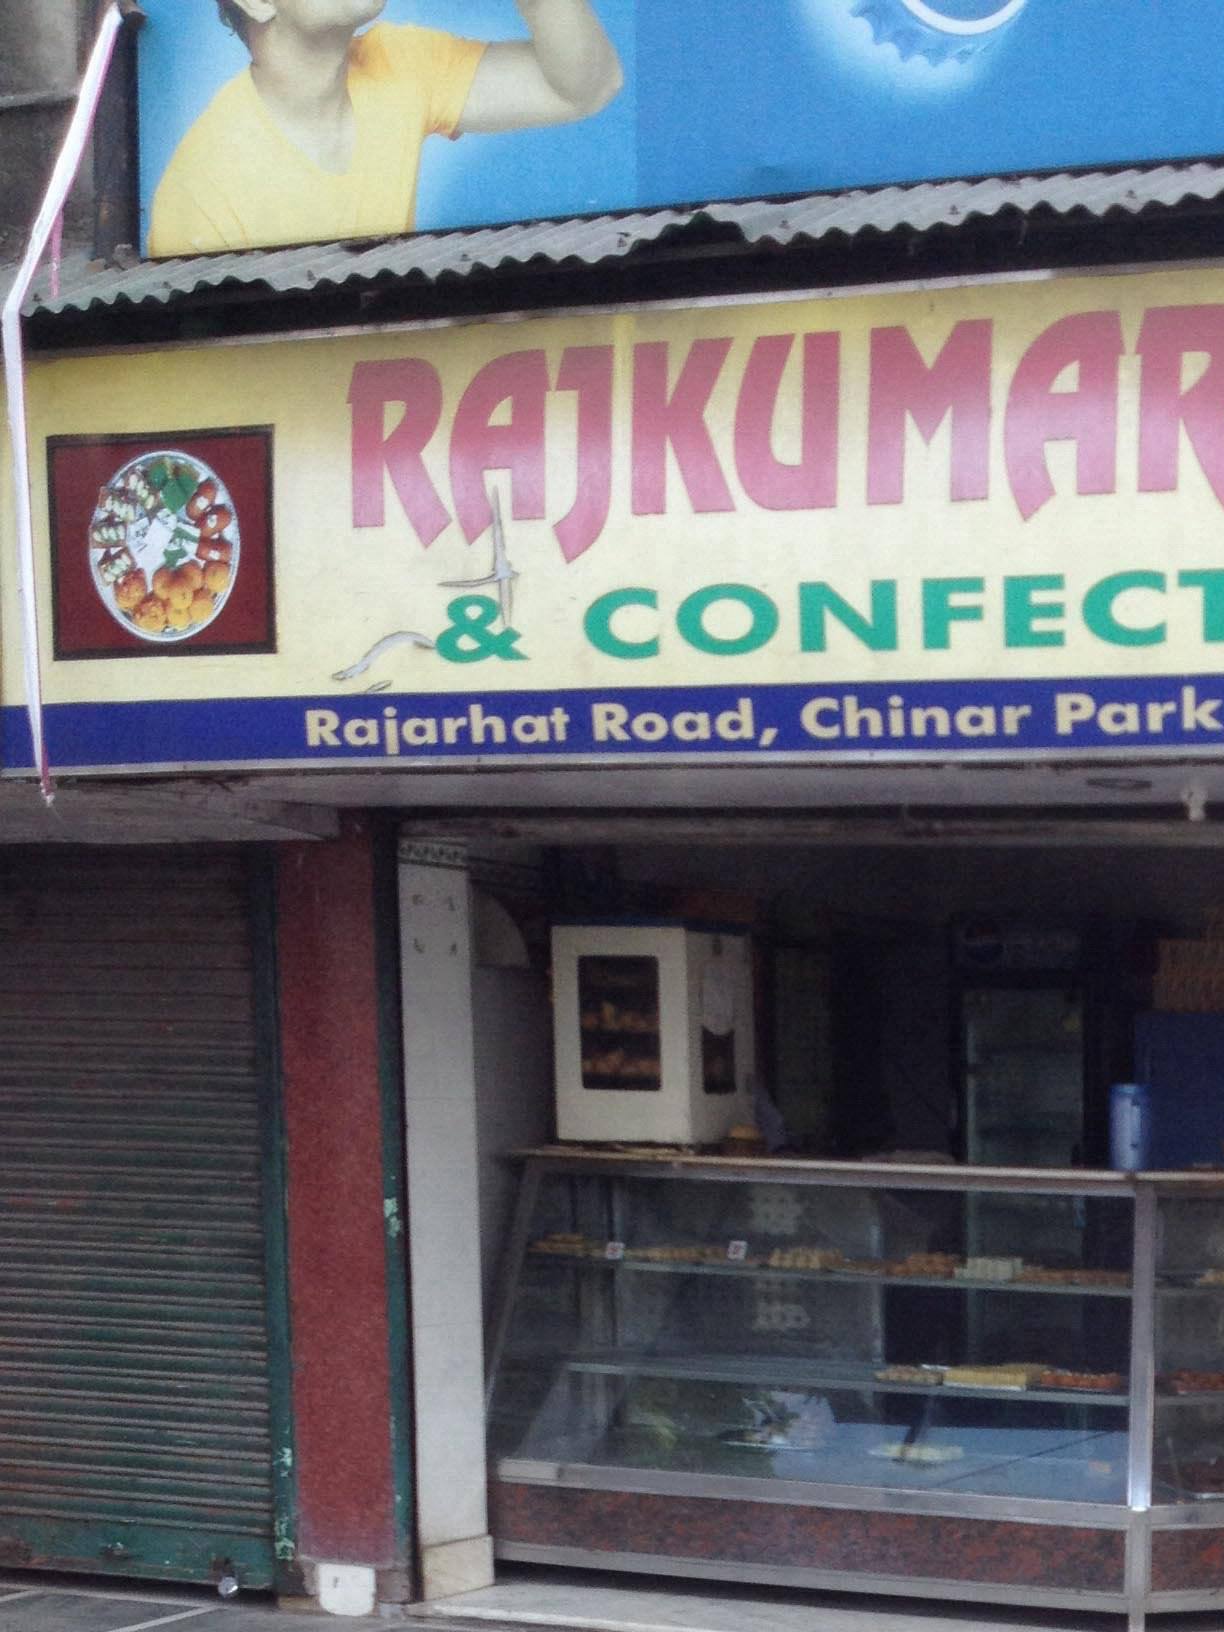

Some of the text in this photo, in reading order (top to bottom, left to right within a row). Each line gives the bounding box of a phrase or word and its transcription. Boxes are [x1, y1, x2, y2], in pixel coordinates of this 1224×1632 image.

[435, 594, 530, 664] &
[305, 705, 570, 755] Rajarhat
[592, 698, 777, 747] Road,
[801, 696, 1030, 738] Chinar
